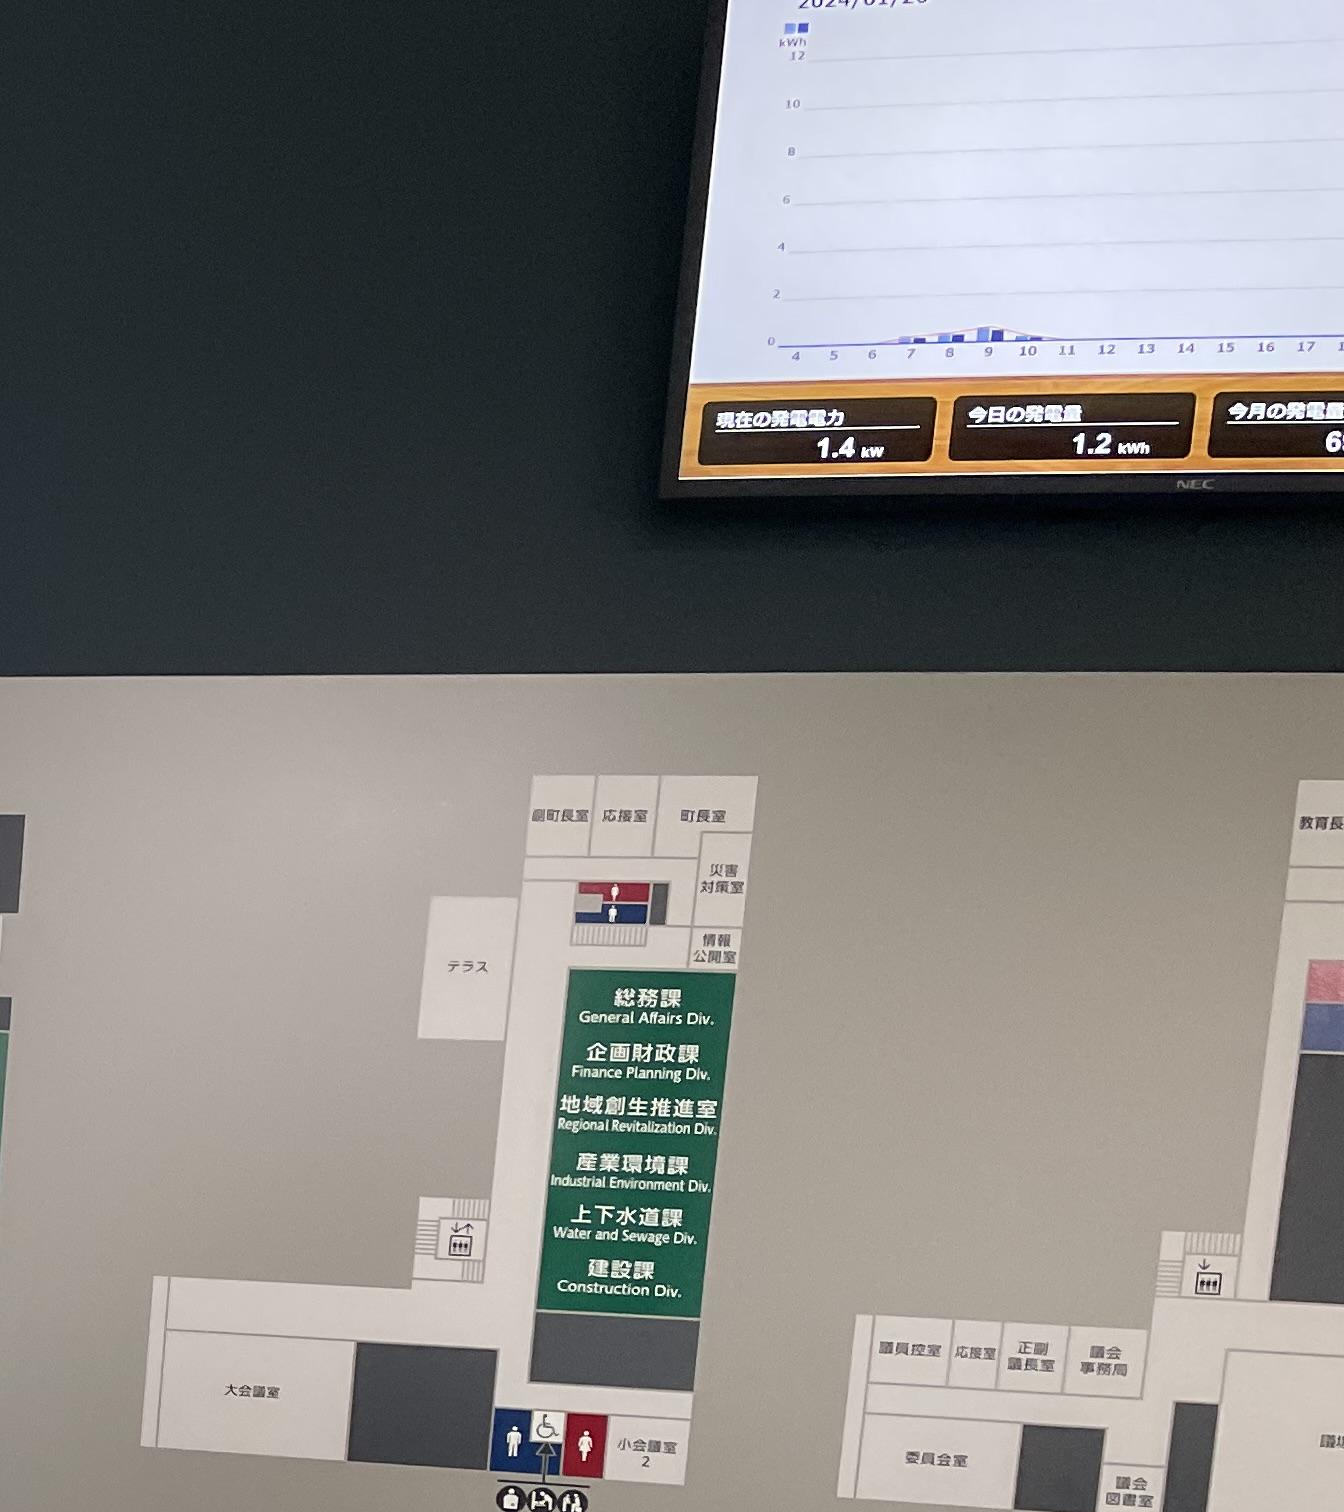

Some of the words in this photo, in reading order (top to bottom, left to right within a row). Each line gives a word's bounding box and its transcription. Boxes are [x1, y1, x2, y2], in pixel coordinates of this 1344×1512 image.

[779, 38, 807, 48] kWh
[791, 351, 801, 362] 4
[829, 350, 838, 360] 5
[868, 350, 877, 360] 6
[906, 348, 916, 360] 7
[945, 348, 954, 358] 8
[984, 346, 994, 358] 9
[1020, 346, 1038, 356] 10
[1058, 346, 1076, 356] 11
[1098, 344, 1116, 355] 12
[1137, 344, 1156, 354] 13
[1177, 343, 1196, 354] 14
[1216, 342, 1235, 353] 15
[1256, 342, 1275, 352] 16
[1297, 342, 1316, 352] 17
[715, 409, 845, 429] 現在の発電電力
[968, 405, 1083, 424] 今日の発電量
[816, 436, 856, 459] 1.4
[860, 446, 885, 458] kW
[1072, 432, 1113, 455] 1.2
[1117, 441, 1151, 455] kWh
[1176, 478, 1217, 490] NEC
[680, 810, 727, 824] 町長室
[448, 961, 488, 973] テラス
[614, 988, 682, 1009] 総務課
[579, 1011, 634, 1025] General
[639, 1011, 683, 1025] Affairs
[687, 1012, 714, 1026] Div.
[586, 1042, 700, 1064] 企画財政課
[571, 1065, 622, 1079] Finance
[626, 1066, 681, 1083] Planning
[686, 1067, 711, 1081] Div.
[559, 1094, 718, 1119] 地域創生推進室
[557, 1118, 609, 1133] Regional
[612, 1119, 690, 1135] Revitalization
[694, 1122, 717, 1135] Div.
[576, 1152, 689, 1176] 産業環境課
[551, 1174, 606, 1188] Industrial
[610, 1176, 685, 1192] Environment
[688, 1179, 712, 1193] Div.
[571, 1205, 684, 1227] 上下水道課
[553, 1226, 591, 1239] Water
[596, 1228, 618, 1241] and
[622, 1229, 670, 1245] Sewage
[674, 1231, 698, 1245] Div.
[588, 1259, 655, 1281] 建設課
[641, 1455, 650, 1469] 2
